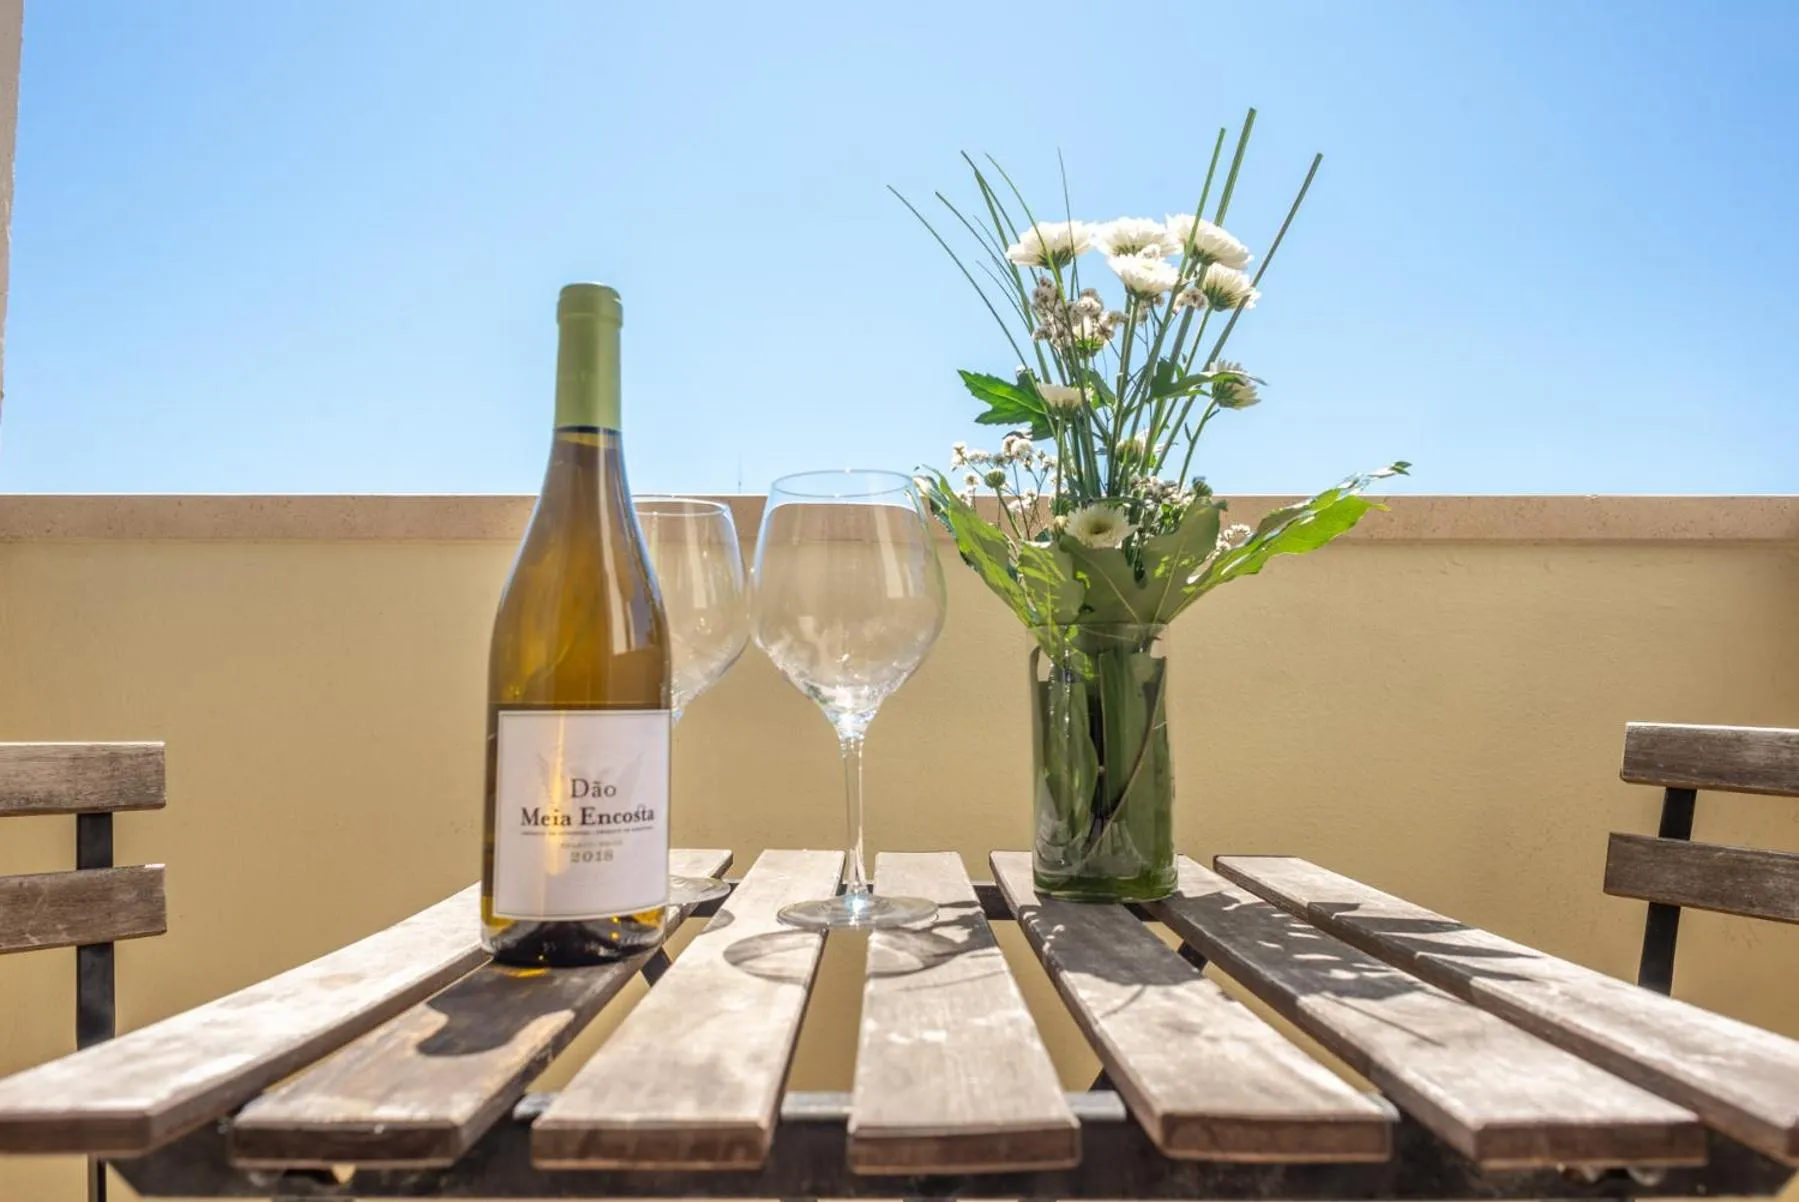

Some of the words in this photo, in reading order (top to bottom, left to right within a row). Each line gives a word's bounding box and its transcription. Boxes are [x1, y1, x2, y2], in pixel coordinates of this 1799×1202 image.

[571, 778, 617, 798] Dão
[521, 806, 572, 826] Meia
[580, 804, 655, 826] Encosta
[570, 850, 613, 863] 2018
